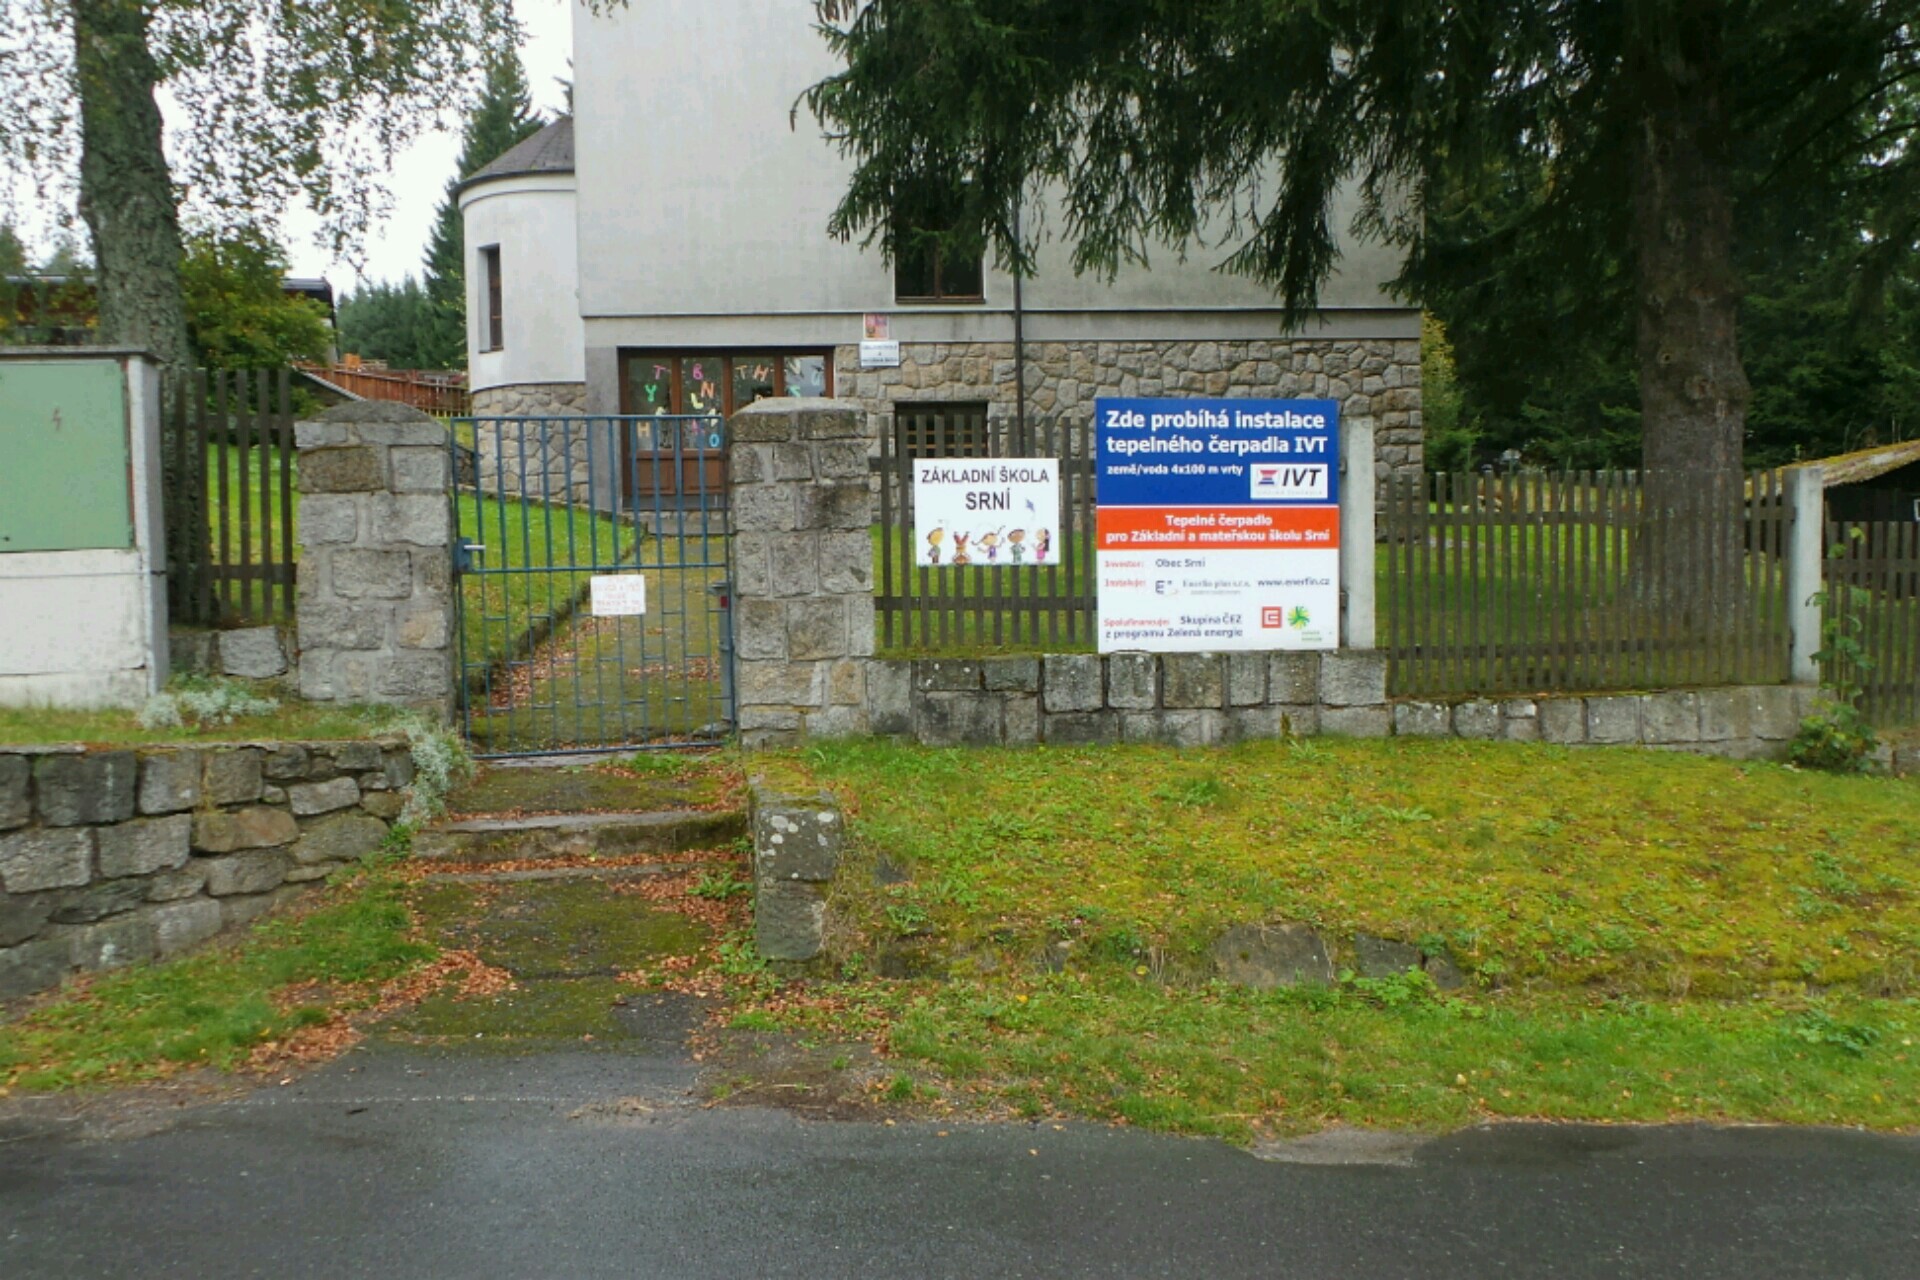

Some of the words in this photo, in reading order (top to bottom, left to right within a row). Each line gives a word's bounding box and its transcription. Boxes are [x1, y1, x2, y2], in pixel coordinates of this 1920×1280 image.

[1106, 410, 1145, 428] Zde
[1151, 409, 1229, 432] probíhá
[1236, 410, 1324, 428] instalace
[1106, 435, 1203, 456] tepelného
[1208, 434, 1289, 456] čerpadla
[1295, 436, 1328, 453] IVT
[922, 466, 995, 483] ZÁKLADNÍ
[1000, 466, 1049, 482] ŠKOLA
[1107, 463, 1168, 475] země/voda
[1171, 464, 1205, 474] 4x100
[1208, 466, 1219, 474] m
[1221, 465, 1243, 476] vrty
[1282, 468, 1322, 486] IVT
[966, 487, 1010, 510] SRNÍ
[1166, 515, 1216, 528] Tepelné
[1219, 514, 1272, 528] čerpadlo
[1106, 533, 1128, 544] pro
[1132, 530, 1185, 542] Základní
[1189, 533, 1196, 541] a
[1200, 530, 1265, 541] mateřskou
[1269, 529, 1301, 541] školu
[1305, 529, 1329, 541] Srní
[1156, 558, 1182, 568] Obec
[1184, 558, 1206, 568] Srní
[1180, 615, 1221, 626] Skupina
[1222, 613, 1242, 624] ČEZ
[1114, 629, 1164, 640] programu
[1166, 628, 1201, 637] Zelená
[1204, 629, 1243, 639] energie
